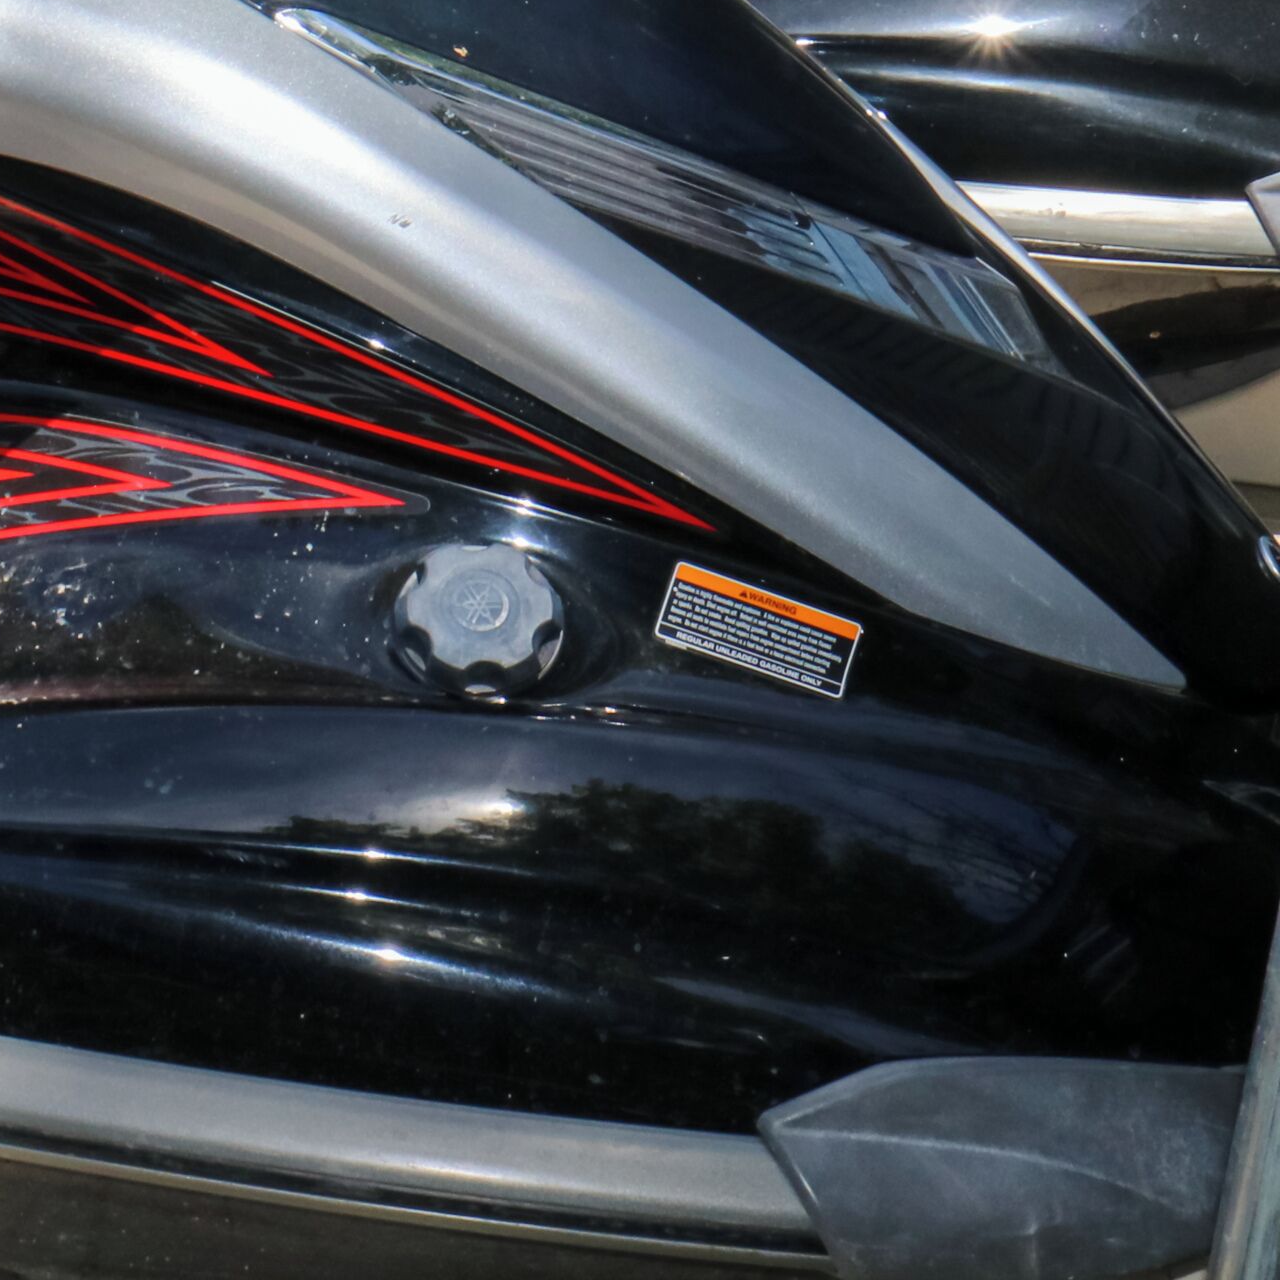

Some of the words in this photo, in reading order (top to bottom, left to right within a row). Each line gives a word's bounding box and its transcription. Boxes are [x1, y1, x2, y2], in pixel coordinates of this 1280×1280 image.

[748, 592, 798, 616] WARNING
[675, 630, 715, 651] REGULAR
[715, 643, 759, 666] UNLEADED
[759, 658, 800, 680] GASOLINE
[800, 673, 823, 687] ONLY
